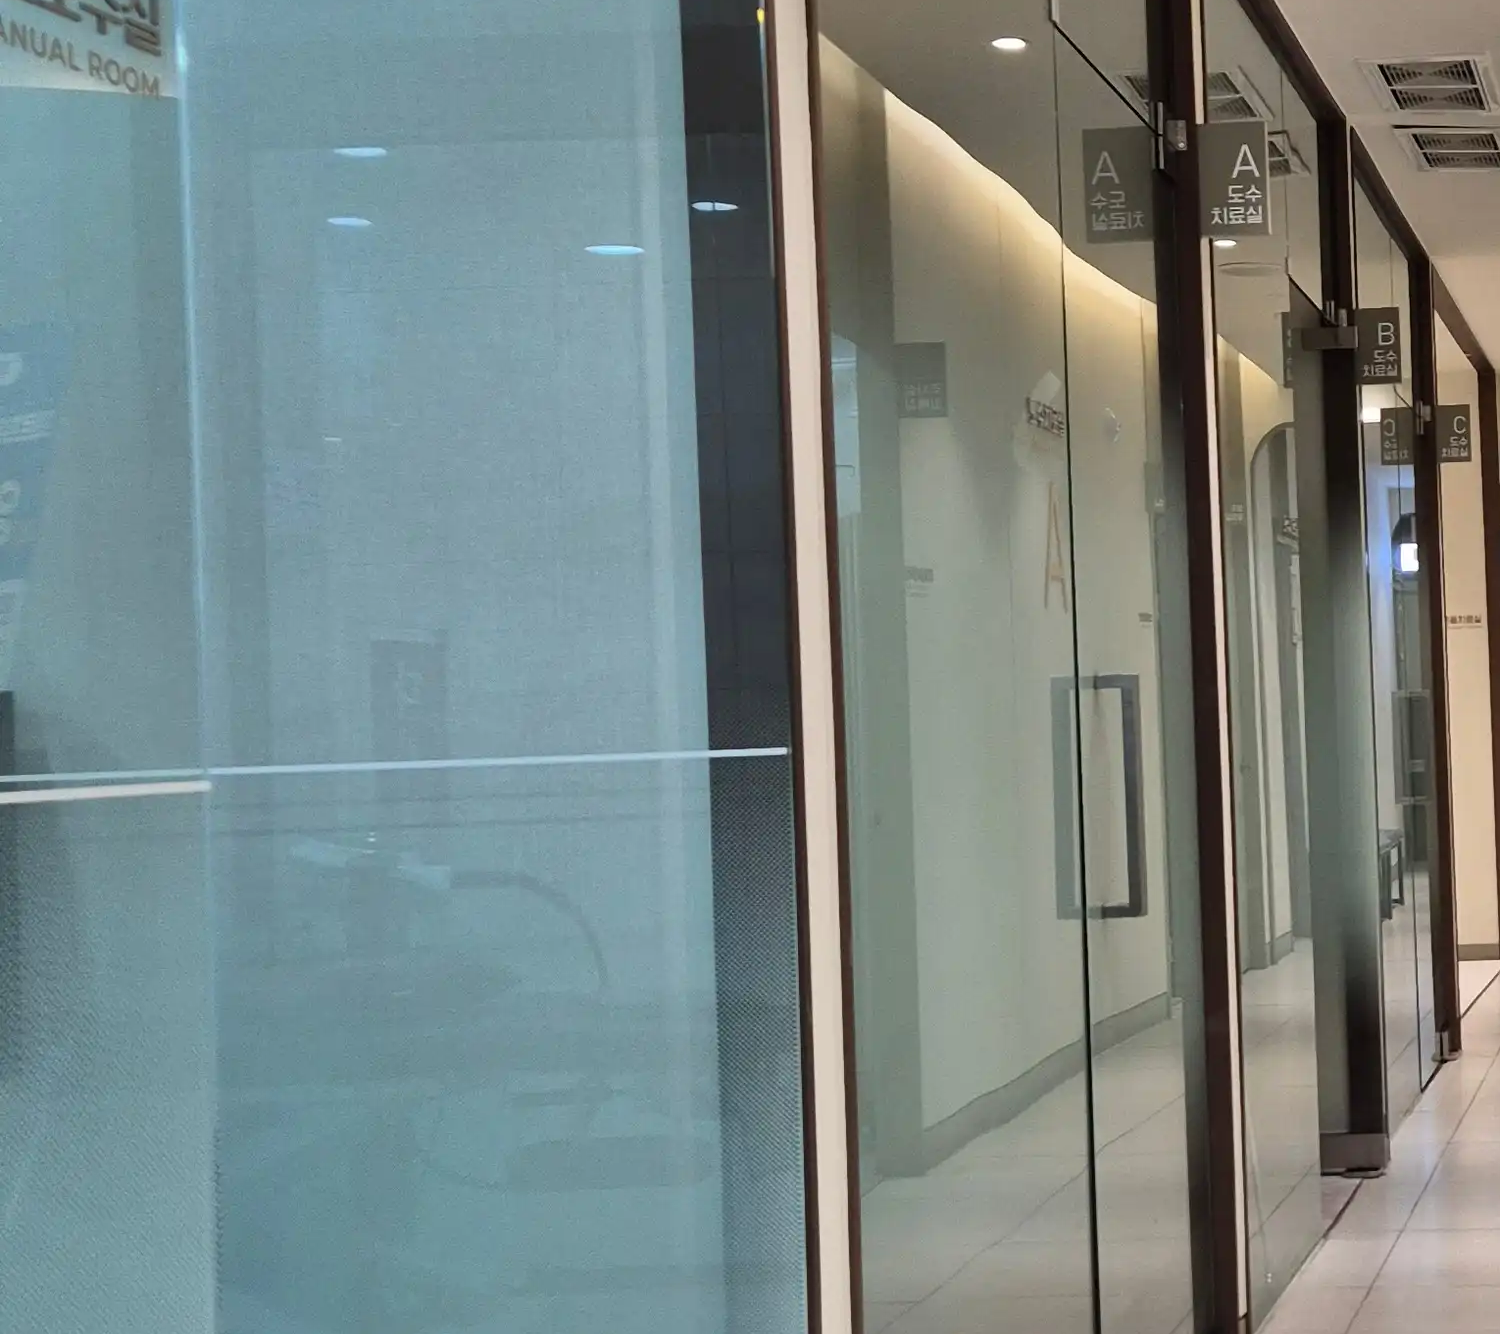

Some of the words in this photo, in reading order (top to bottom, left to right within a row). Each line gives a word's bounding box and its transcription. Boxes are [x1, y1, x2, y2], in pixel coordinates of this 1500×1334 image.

[88, 49, 161, 100] ROOM
[1232, 143, 1260, 178] A
[1227, 184, 1262, 204] 도수
[1210, 205, 1263, 226] 치료실
[1378, 322, 1394, 346] B
[1374, 349, 1398, 363] 도수
[1363, 364, 1398, 378] 치료실
[1453, 415, 1467, 434] C
